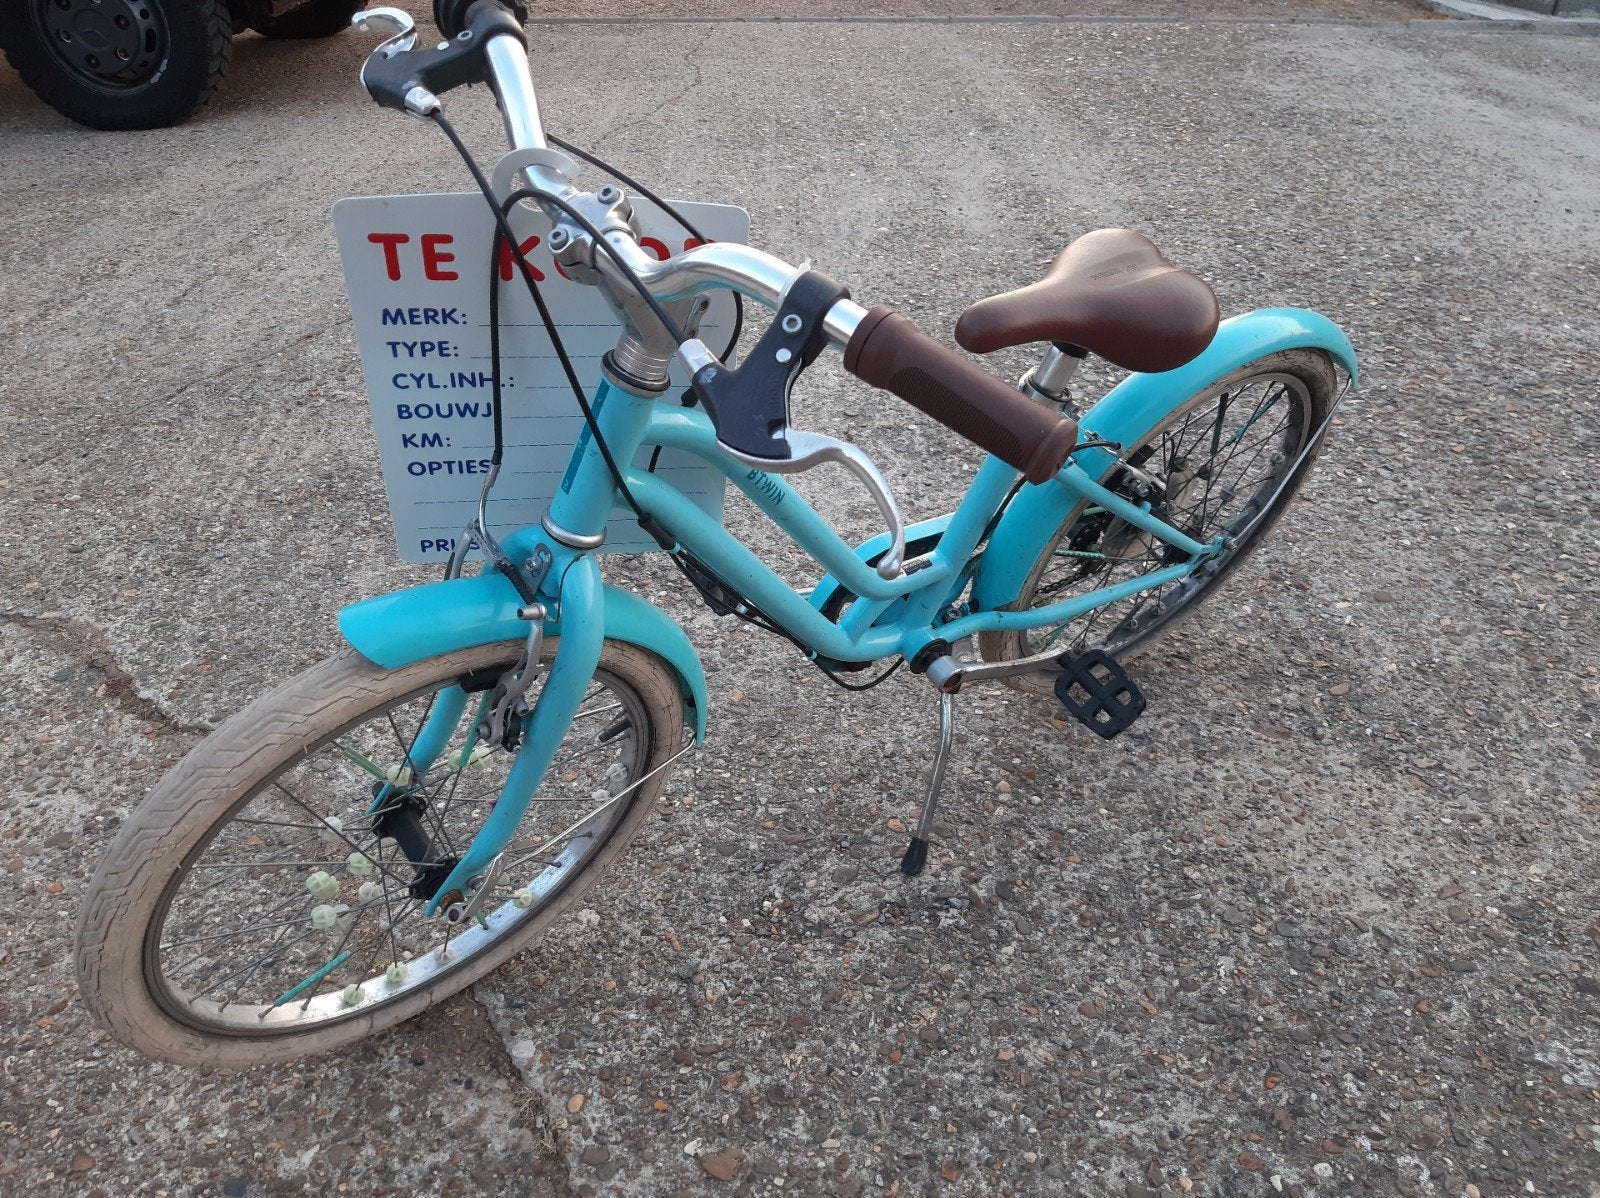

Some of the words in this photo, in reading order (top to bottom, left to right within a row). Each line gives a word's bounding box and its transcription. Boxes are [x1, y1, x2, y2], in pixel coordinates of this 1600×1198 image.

[367, 233, 459, 281] TE
[382, 307, 468, 326] MERK:
[385, 341, 459, 358] TYPE:
[401, 432, 452, 449] KM:
[420, 538, 481, 553] PRIS
